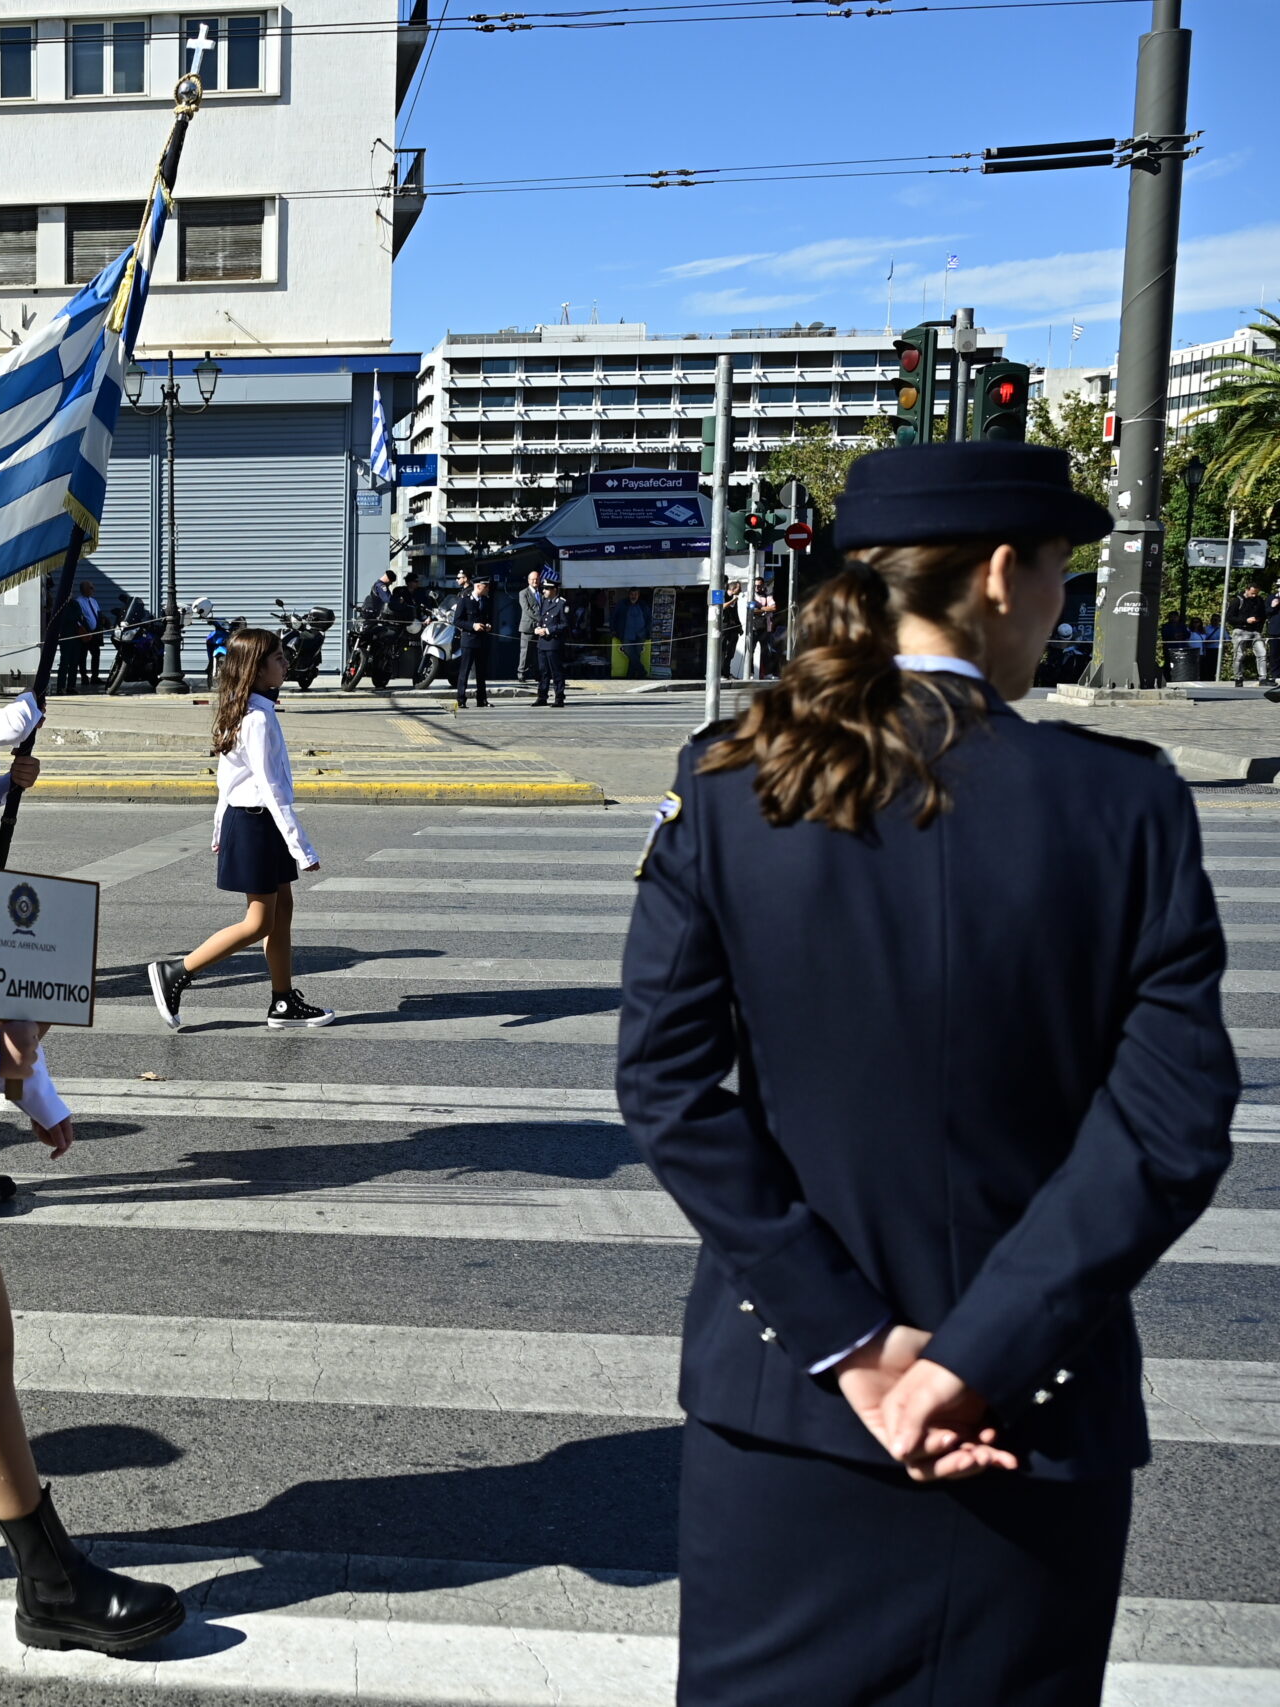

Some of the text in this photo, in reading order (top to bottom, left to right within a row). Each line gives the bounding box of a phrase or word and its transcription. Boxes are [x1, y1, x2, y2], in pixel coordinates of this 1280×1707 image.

[622, 478, 683, 489] PaysafeCard
[17, 941, 57, 952] ΑΘΗΝΑΙΩΝ
[6, 978, 90, 1004] ΔΗΜΟΤΙΚΟ
